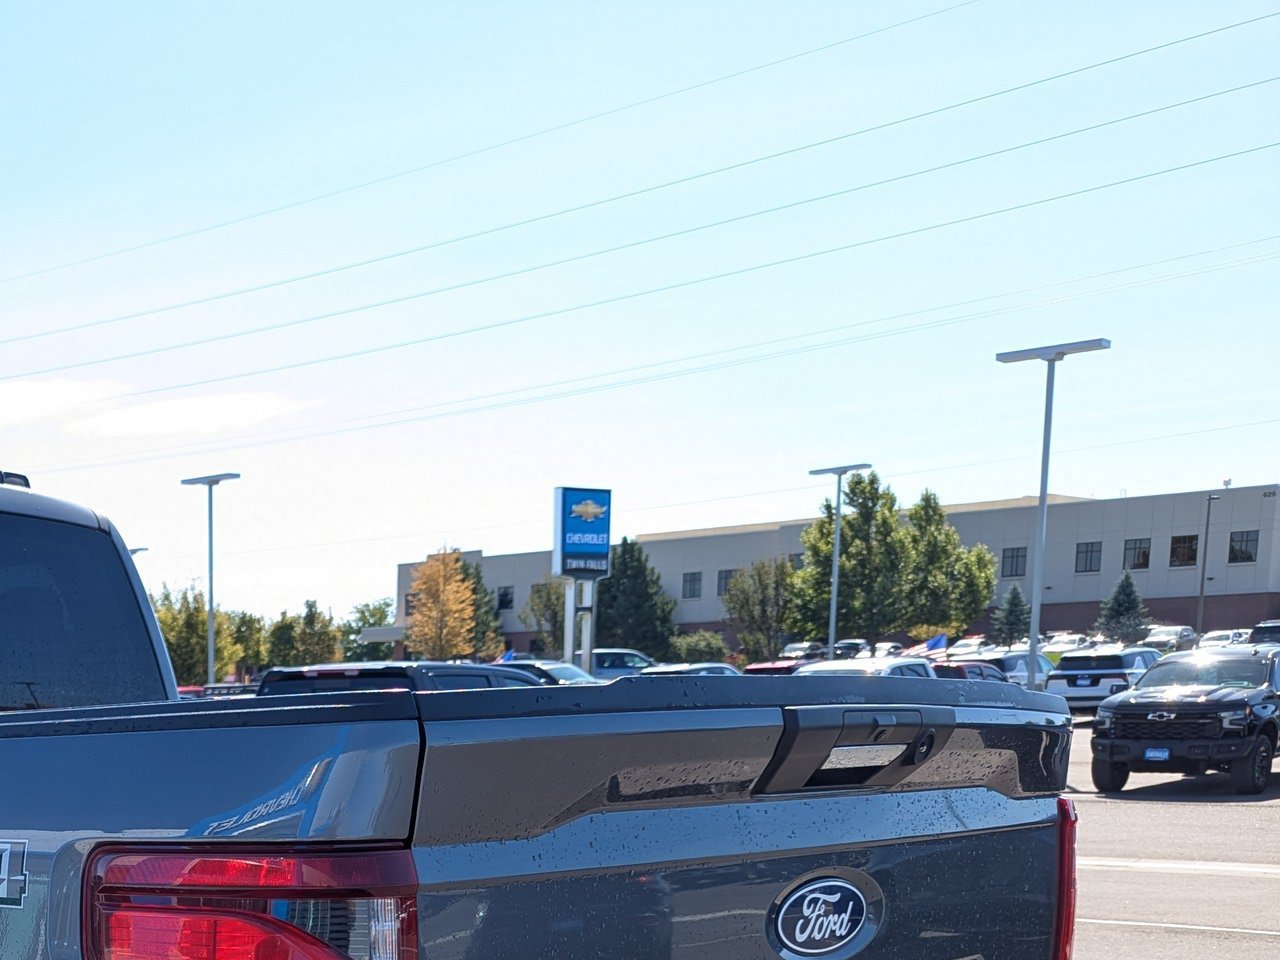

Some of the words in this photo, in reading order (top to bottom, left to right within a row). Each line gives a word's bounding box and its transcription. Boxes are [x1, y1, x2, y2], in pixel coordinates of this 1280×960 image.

[565, 533, 608, 544] CHEVROLET
[566, 559, 585, 569] TWIN
[586, 559, 608, 570] FALLS
[794, 892, 854, 943] Ford
